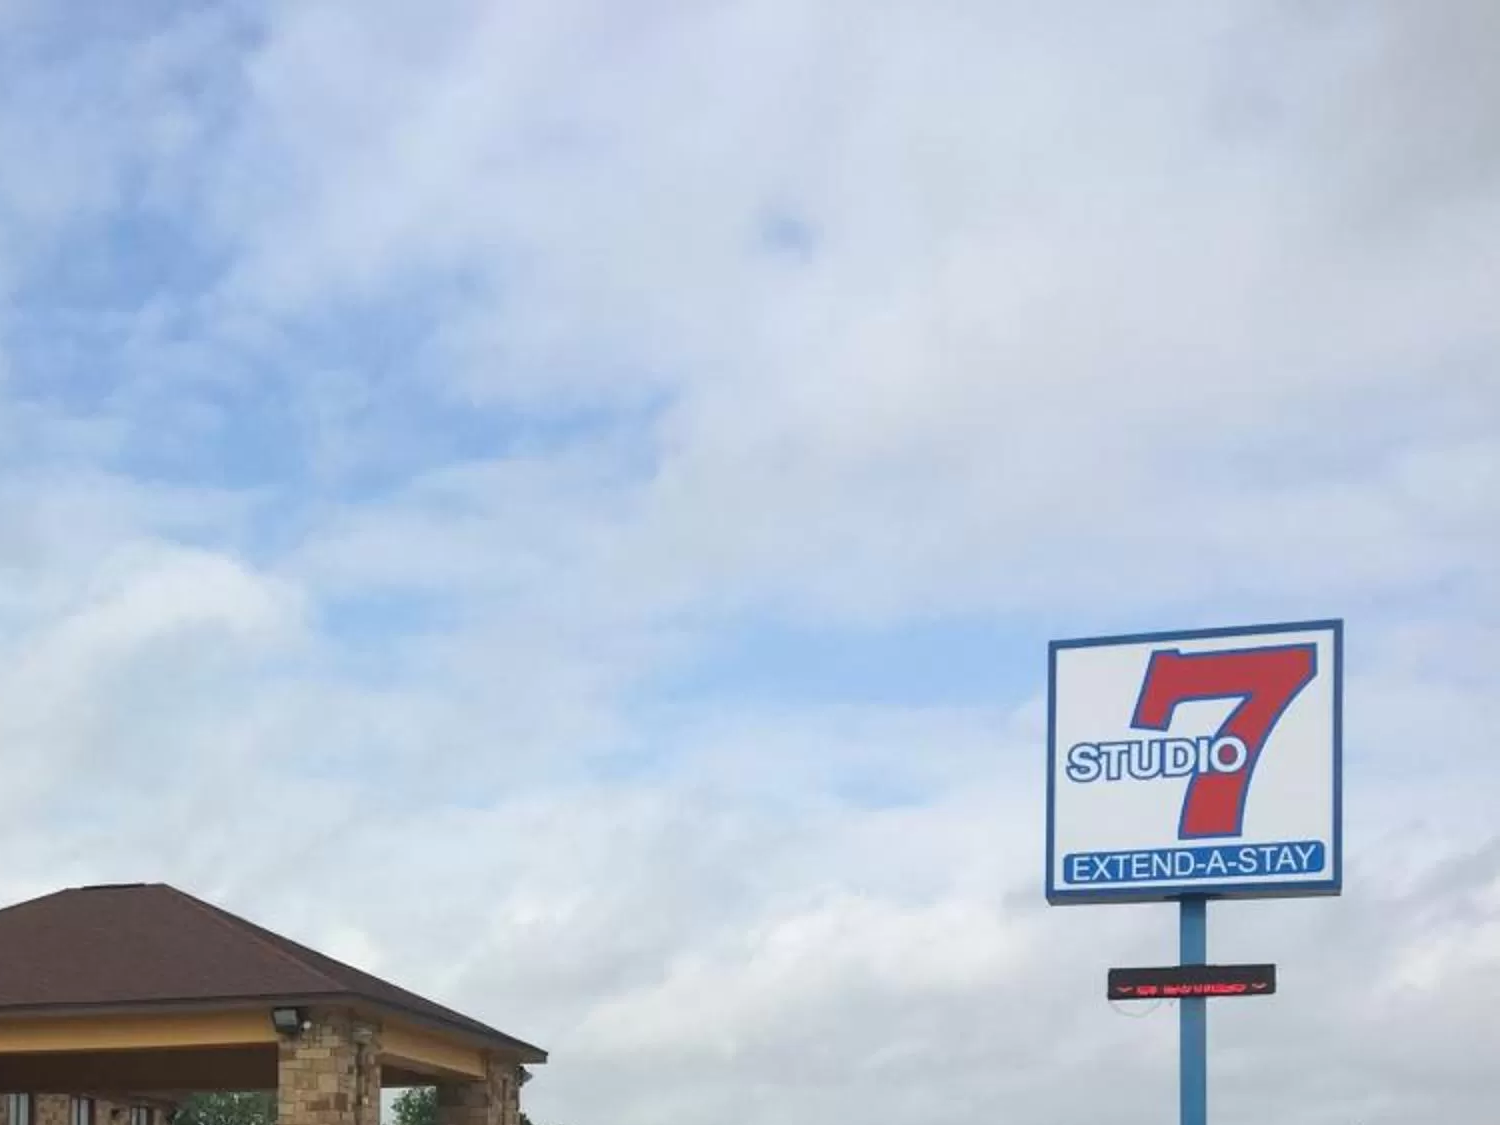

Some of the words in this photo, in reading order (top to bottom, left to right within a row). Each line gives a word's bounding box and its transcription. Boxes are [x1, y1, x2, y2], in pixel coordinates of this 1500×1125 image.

[1066, 736, 1247, 782] STUDIO
[1130, 642, 1318, 840] 7
[1073, 845, 1317, 881] EXTEND-A-STAY
